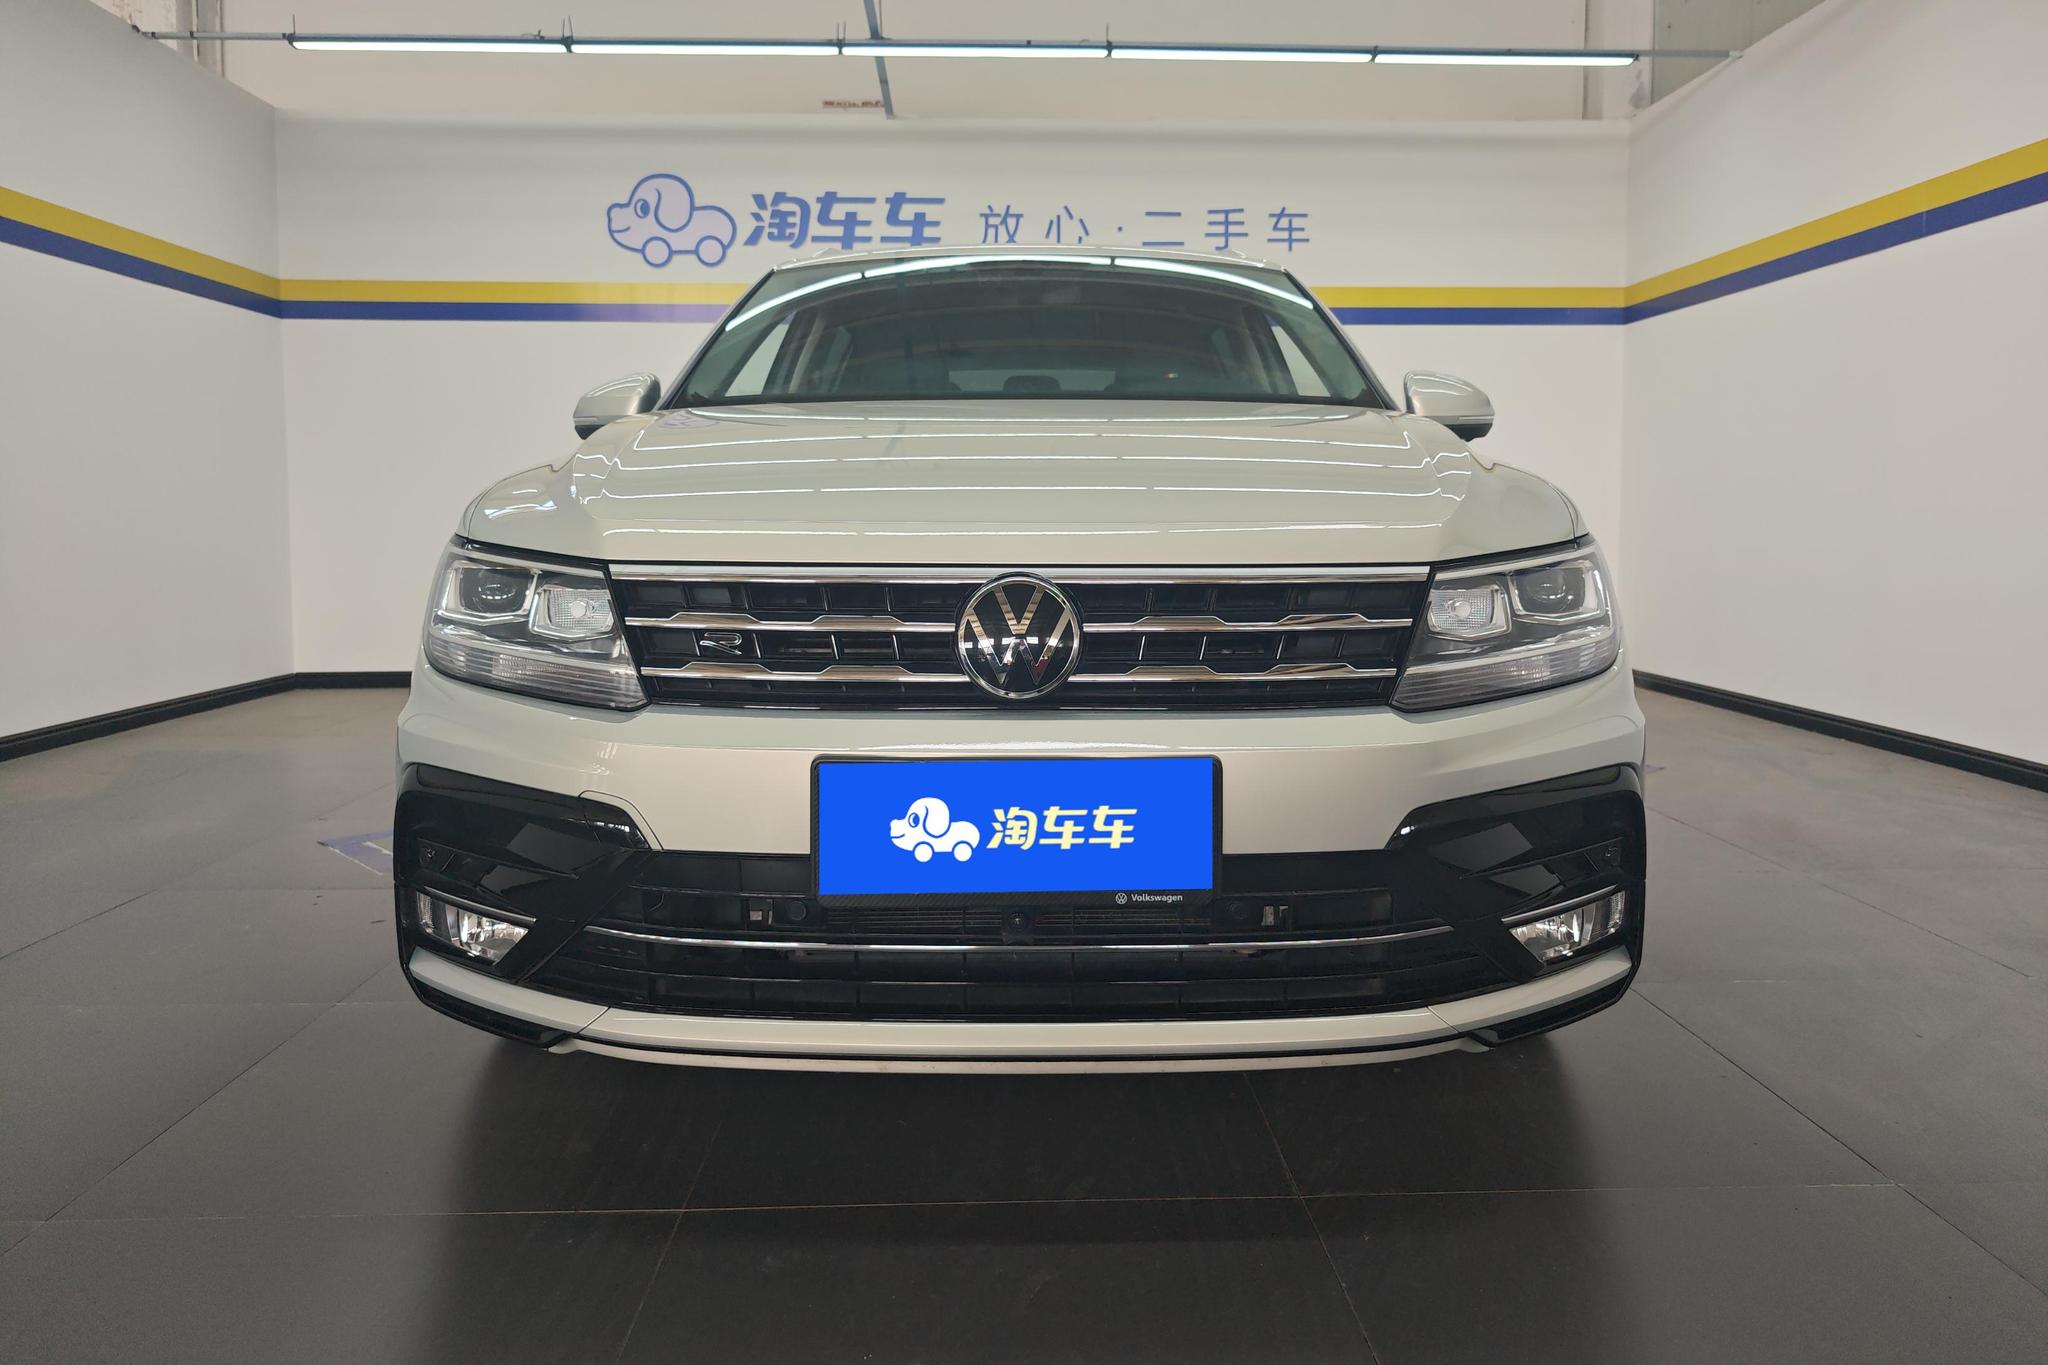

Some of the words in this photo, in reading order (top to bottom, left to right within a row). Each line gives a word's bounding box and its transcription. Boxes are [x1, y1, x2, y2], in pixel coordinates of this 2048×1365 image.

[743, 191, 945, 249] 淘车车
[1131, 893, 1183, 903] Volkswagen
